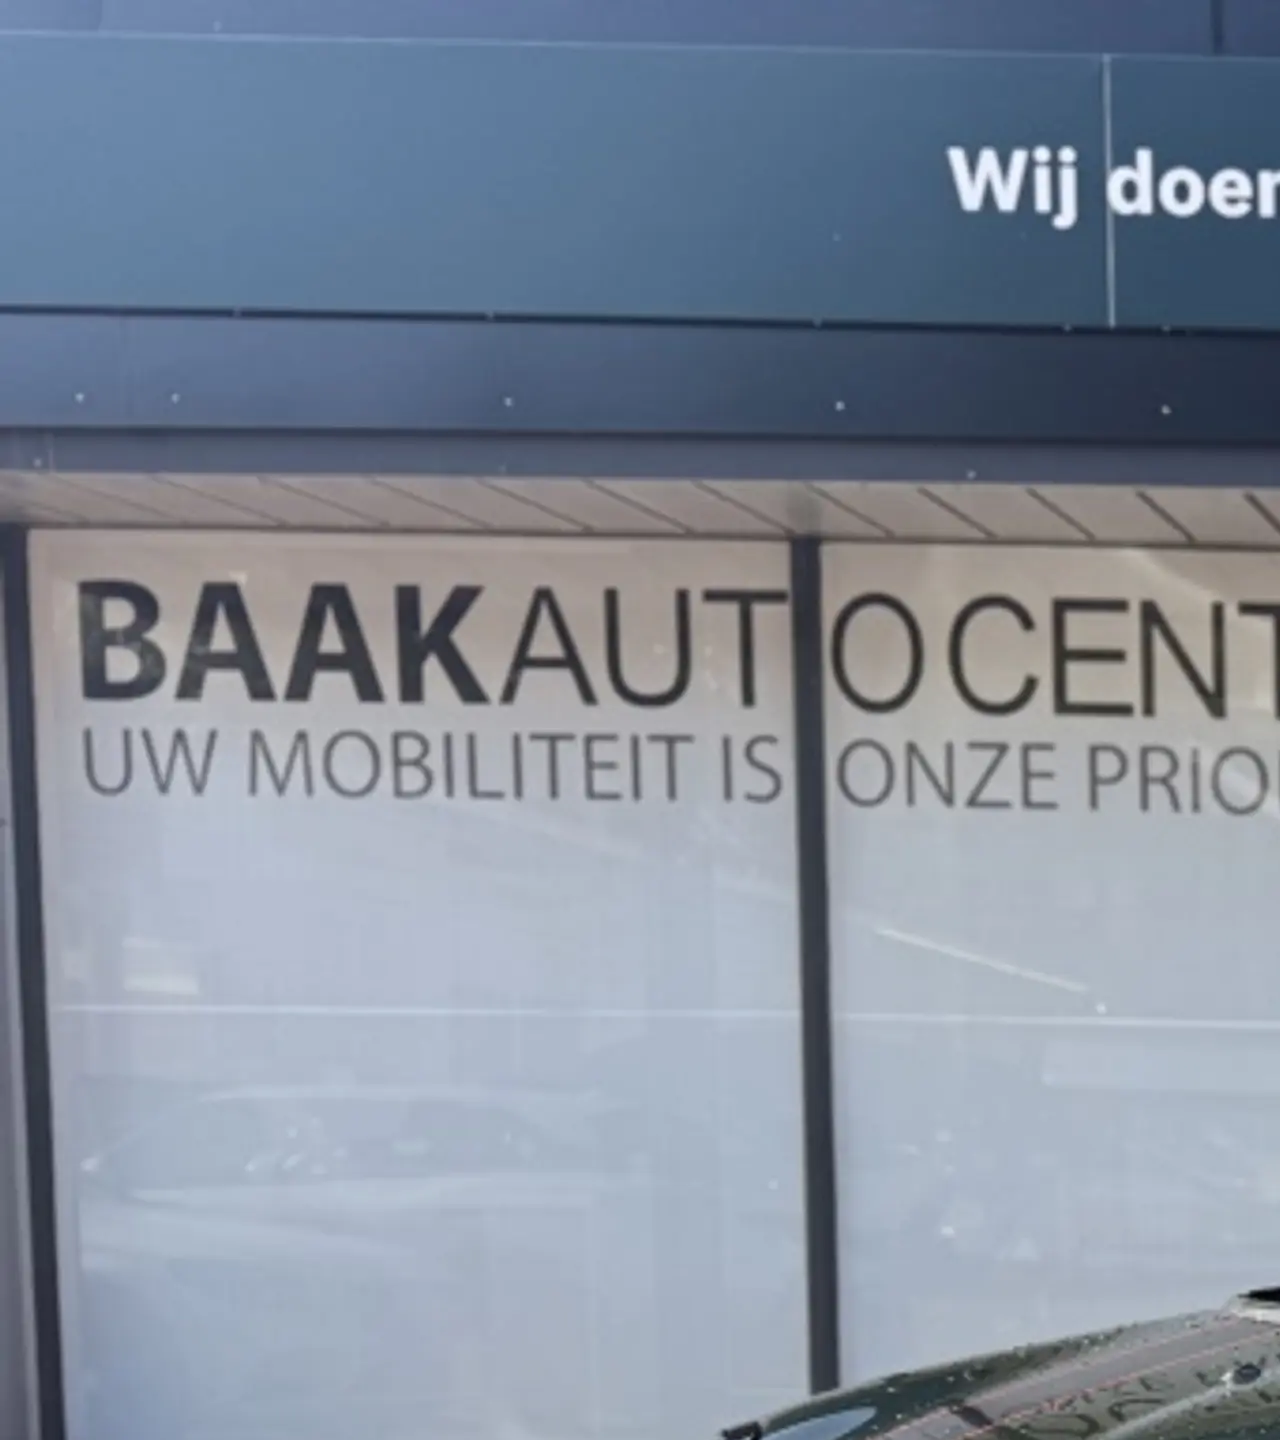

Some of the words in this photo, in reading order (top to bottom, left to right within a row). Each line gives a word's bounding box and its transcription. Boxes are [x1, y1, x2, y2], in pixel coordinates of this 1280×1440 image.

[947, 145, 1077, 230] Wij
[83, 727, 218, 796] UW
[248, 729, 695, 801] MOBILITEIT
[721, 734, 784, 804] IS
[836, 738, 1059, 810] ONZE
